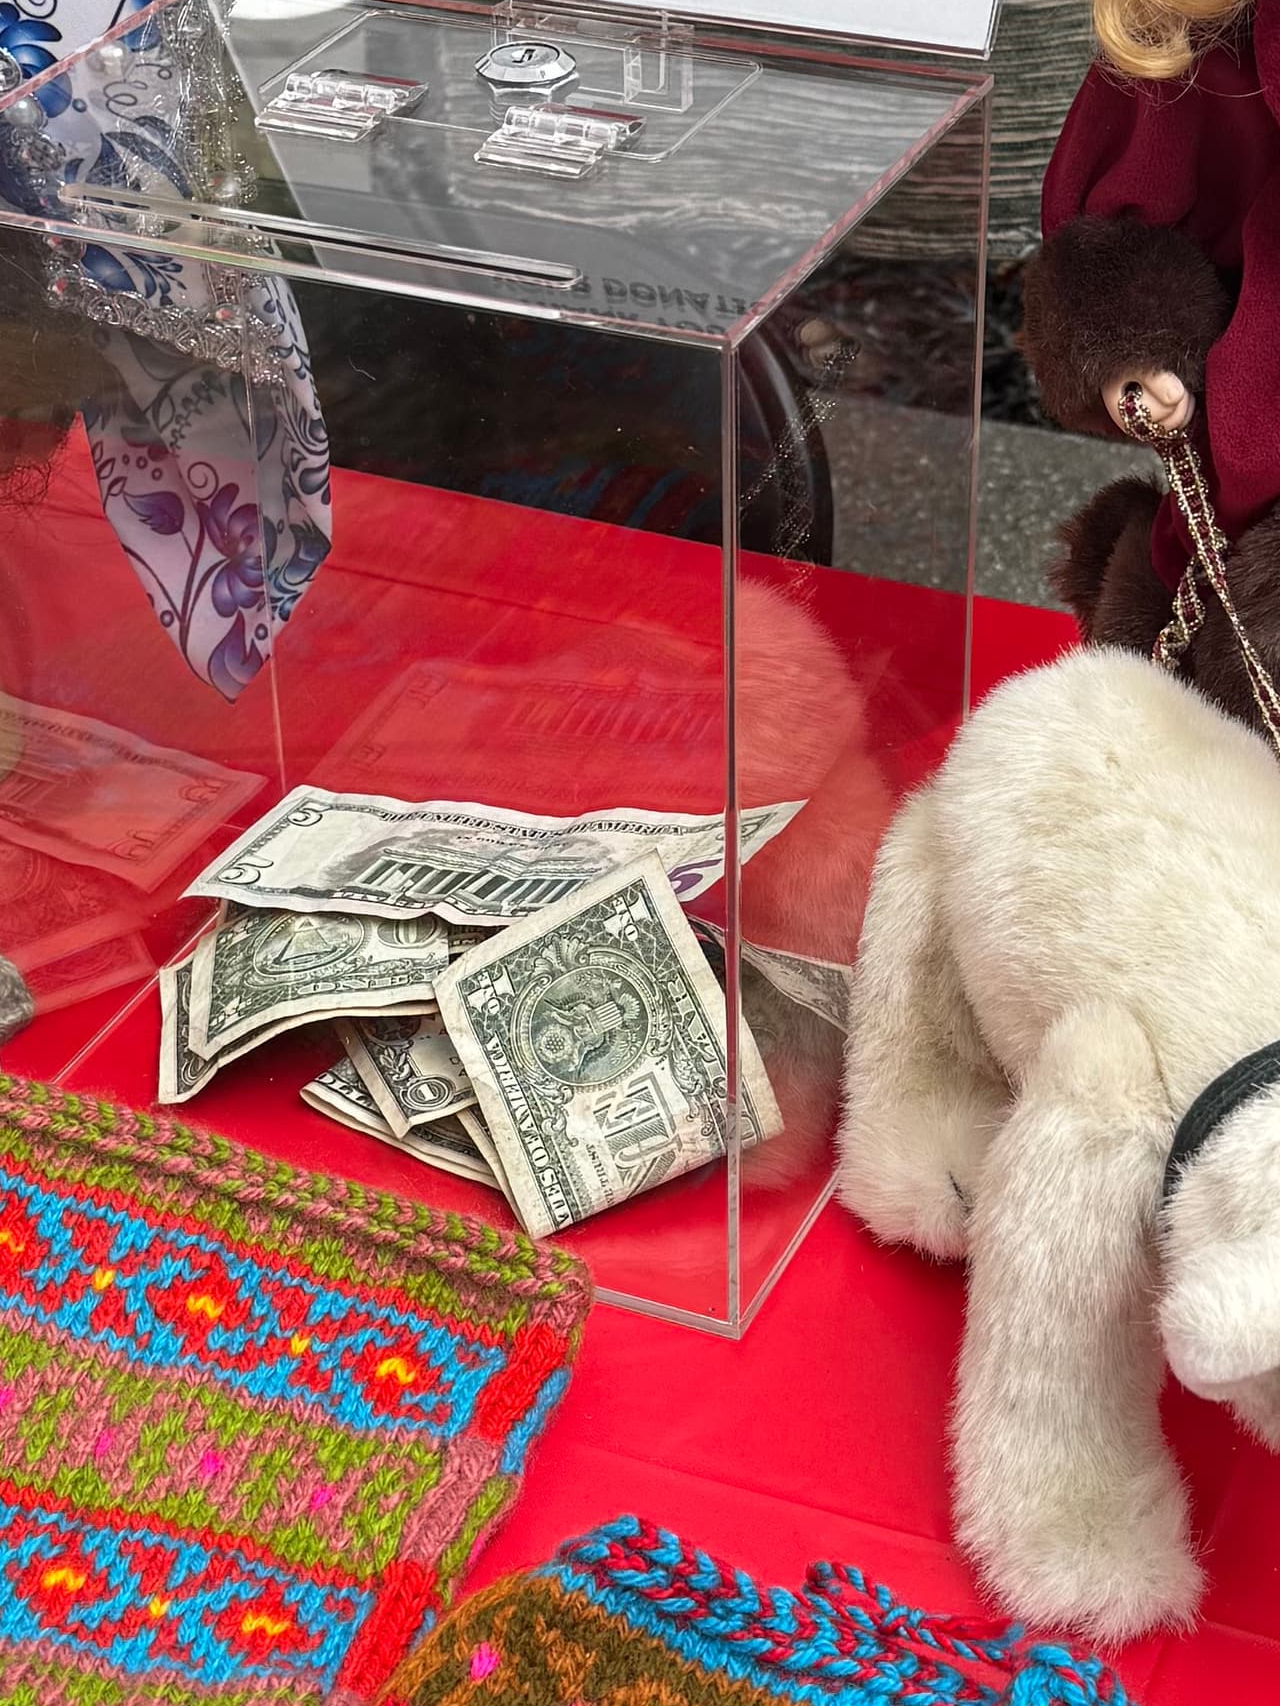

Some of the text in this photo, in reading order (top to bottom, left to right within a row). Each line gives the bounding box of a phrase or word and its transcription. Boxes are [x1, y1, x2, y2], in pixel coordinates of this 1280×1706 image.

[287, 799, 333, 827] 5
[417, 810, 491, 830] UNITED
[589, 820, 688, 837] AMERICA
[218, 853, 275, 886] 5
[482, 1031, 538, 1135] AMERICA
